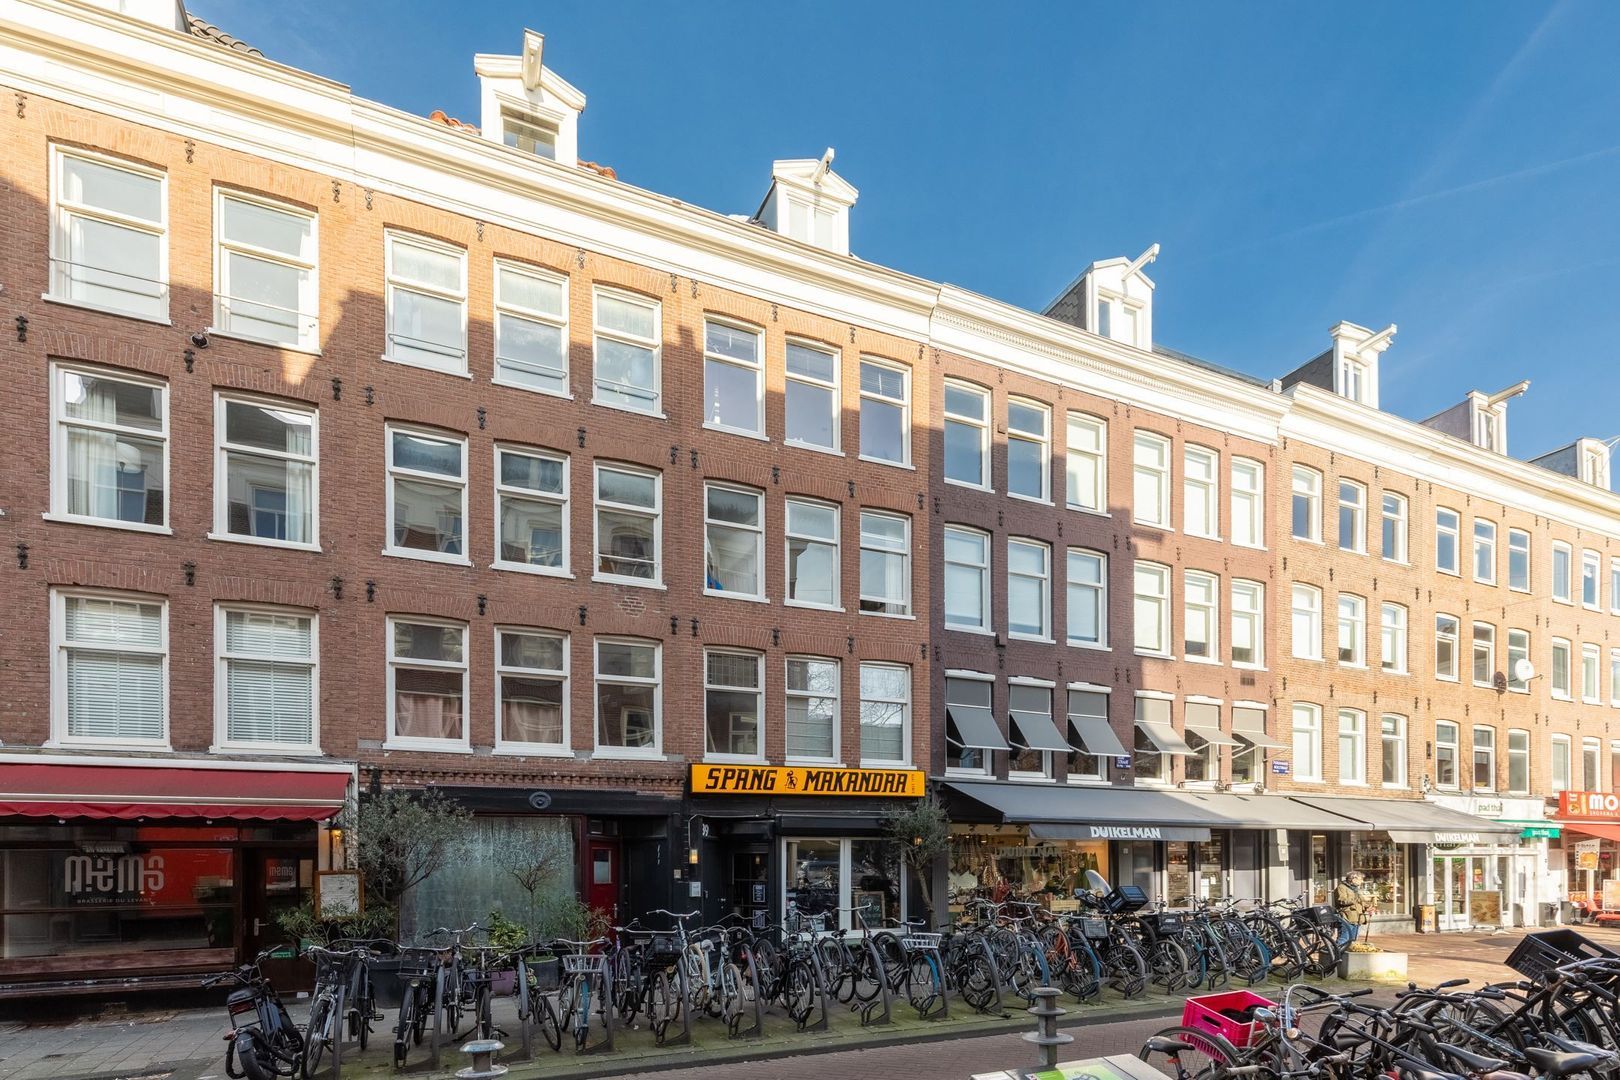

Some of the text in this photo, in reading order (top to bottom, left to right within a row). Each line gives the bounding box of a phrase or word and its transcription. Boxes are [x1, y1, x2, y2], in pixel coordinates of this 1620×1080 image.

[705, 767, 778, 791] SPANG
[802, 770, 908, 793] MAKANDRA
[1089, 825, 1162, 839] DUIKELMAN
[1434, 832, 1480, 843] DUIKELMAN
